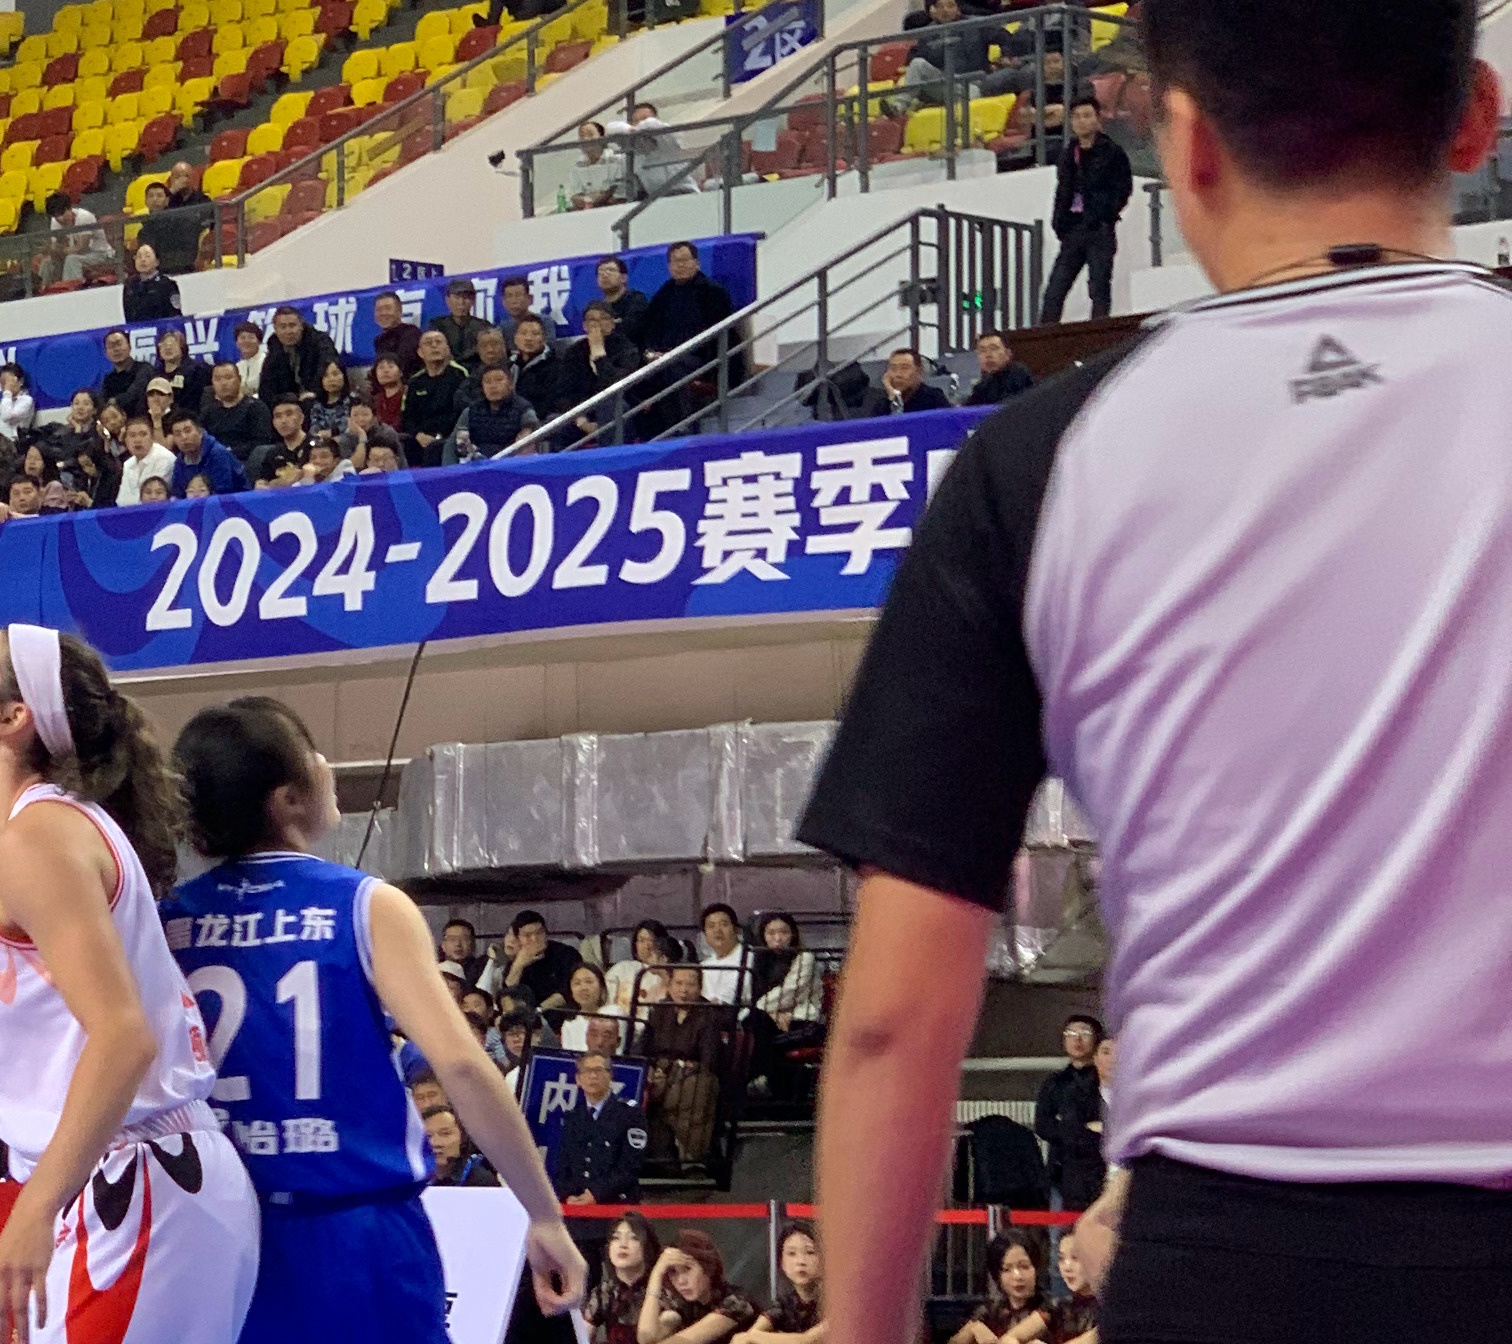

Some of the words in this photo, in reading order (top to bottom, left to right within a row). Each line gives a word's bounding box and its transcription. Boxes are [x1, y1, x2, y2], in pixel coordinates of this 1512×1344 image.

[146, 435, 954, 632] 2024-2025赛季
[188, 960, 322, 1101] 21
[212, 1109, 339, 1155] 怡璐
